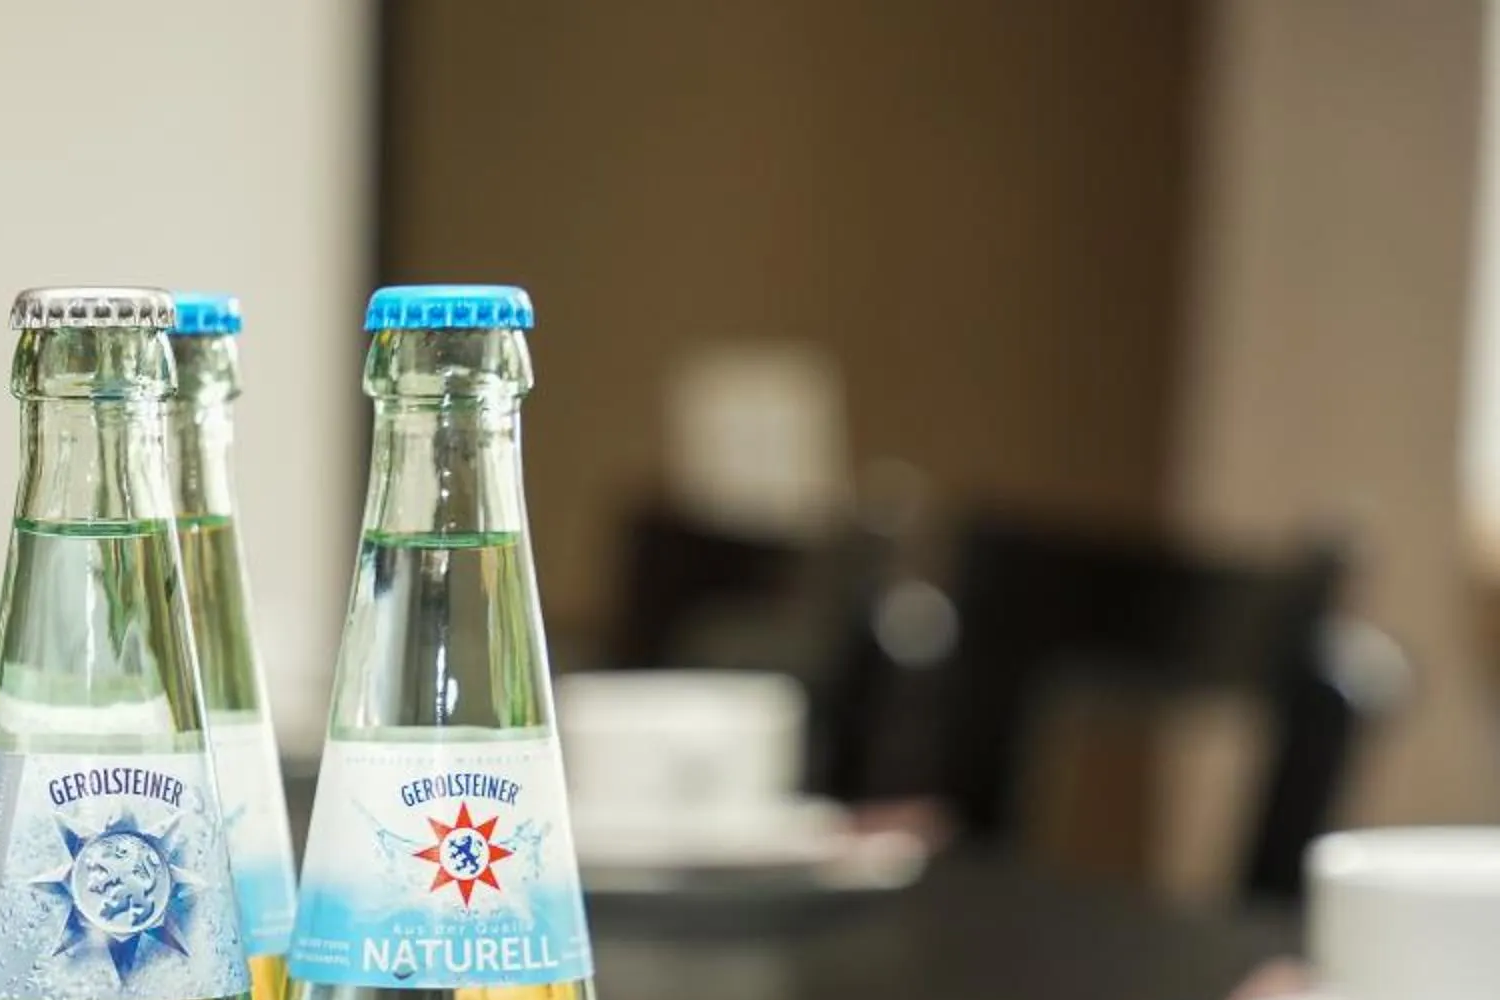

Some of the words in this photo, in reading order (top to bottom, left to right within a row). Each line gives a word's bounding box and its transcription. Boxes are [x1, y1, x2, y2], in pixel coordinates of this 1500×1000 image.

[50, 768, 184, 807] GEROLSTEINER
[401, 773, 519, 807] GEROLSTEINER
[362, 936, 560, 973] NATURELL
